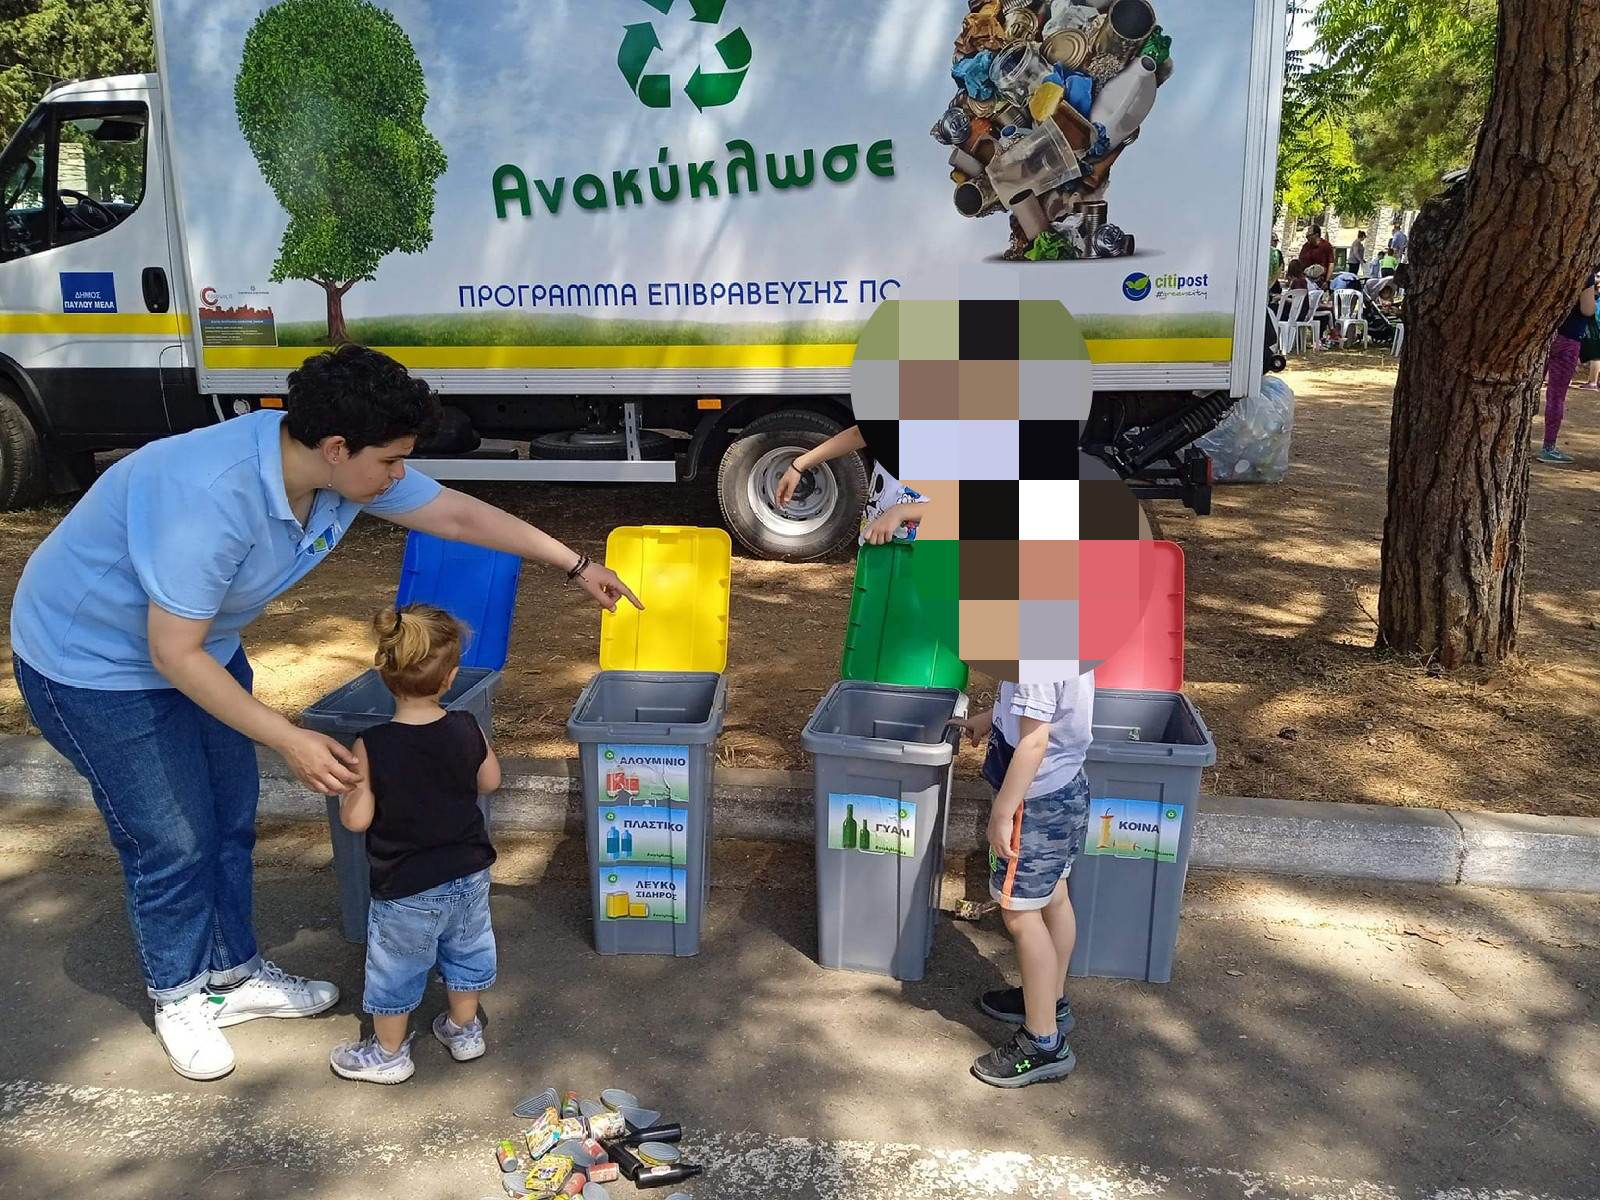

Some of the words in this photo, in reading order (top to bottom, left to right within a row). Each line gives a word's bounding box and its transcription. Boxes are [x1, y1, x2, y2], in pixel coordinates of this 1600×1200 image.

[491, 138, 895, 218] Ανακύκλωσε
[1155, 273, 1208, 289] citipost
[75, 291, 101, 299] ΔΗΜΟΣ
[459, 283, 637, 307] ΠΡΟΓΡΑΜΜΑ
[649, 280, 848, 306] ΕΠΙΒΡΑΒΕΥΣΗΣ
[860, 279, 900, 302] ΠΟ
[64, 301, 92, 309] ΠΑΥΛΟΥ
[95, 301, 115, 309] ΜΕΛΑ
[619, 756, 686, 767] ΑΛΟΥΜΙΝΙΟ
[623, 820, 684, 832] ΠΛΑΣΤΙΚΟ
[875, 823, 910, 838] ΓΥΑΛΙ
[1118, 821, 1160, 834] ΚΟΙΝΑ
[635, 880, 676, 891] ΛΕΥΚΟ
[635, 891, 677, 901] ΣΙΔΗΡΟΣ
